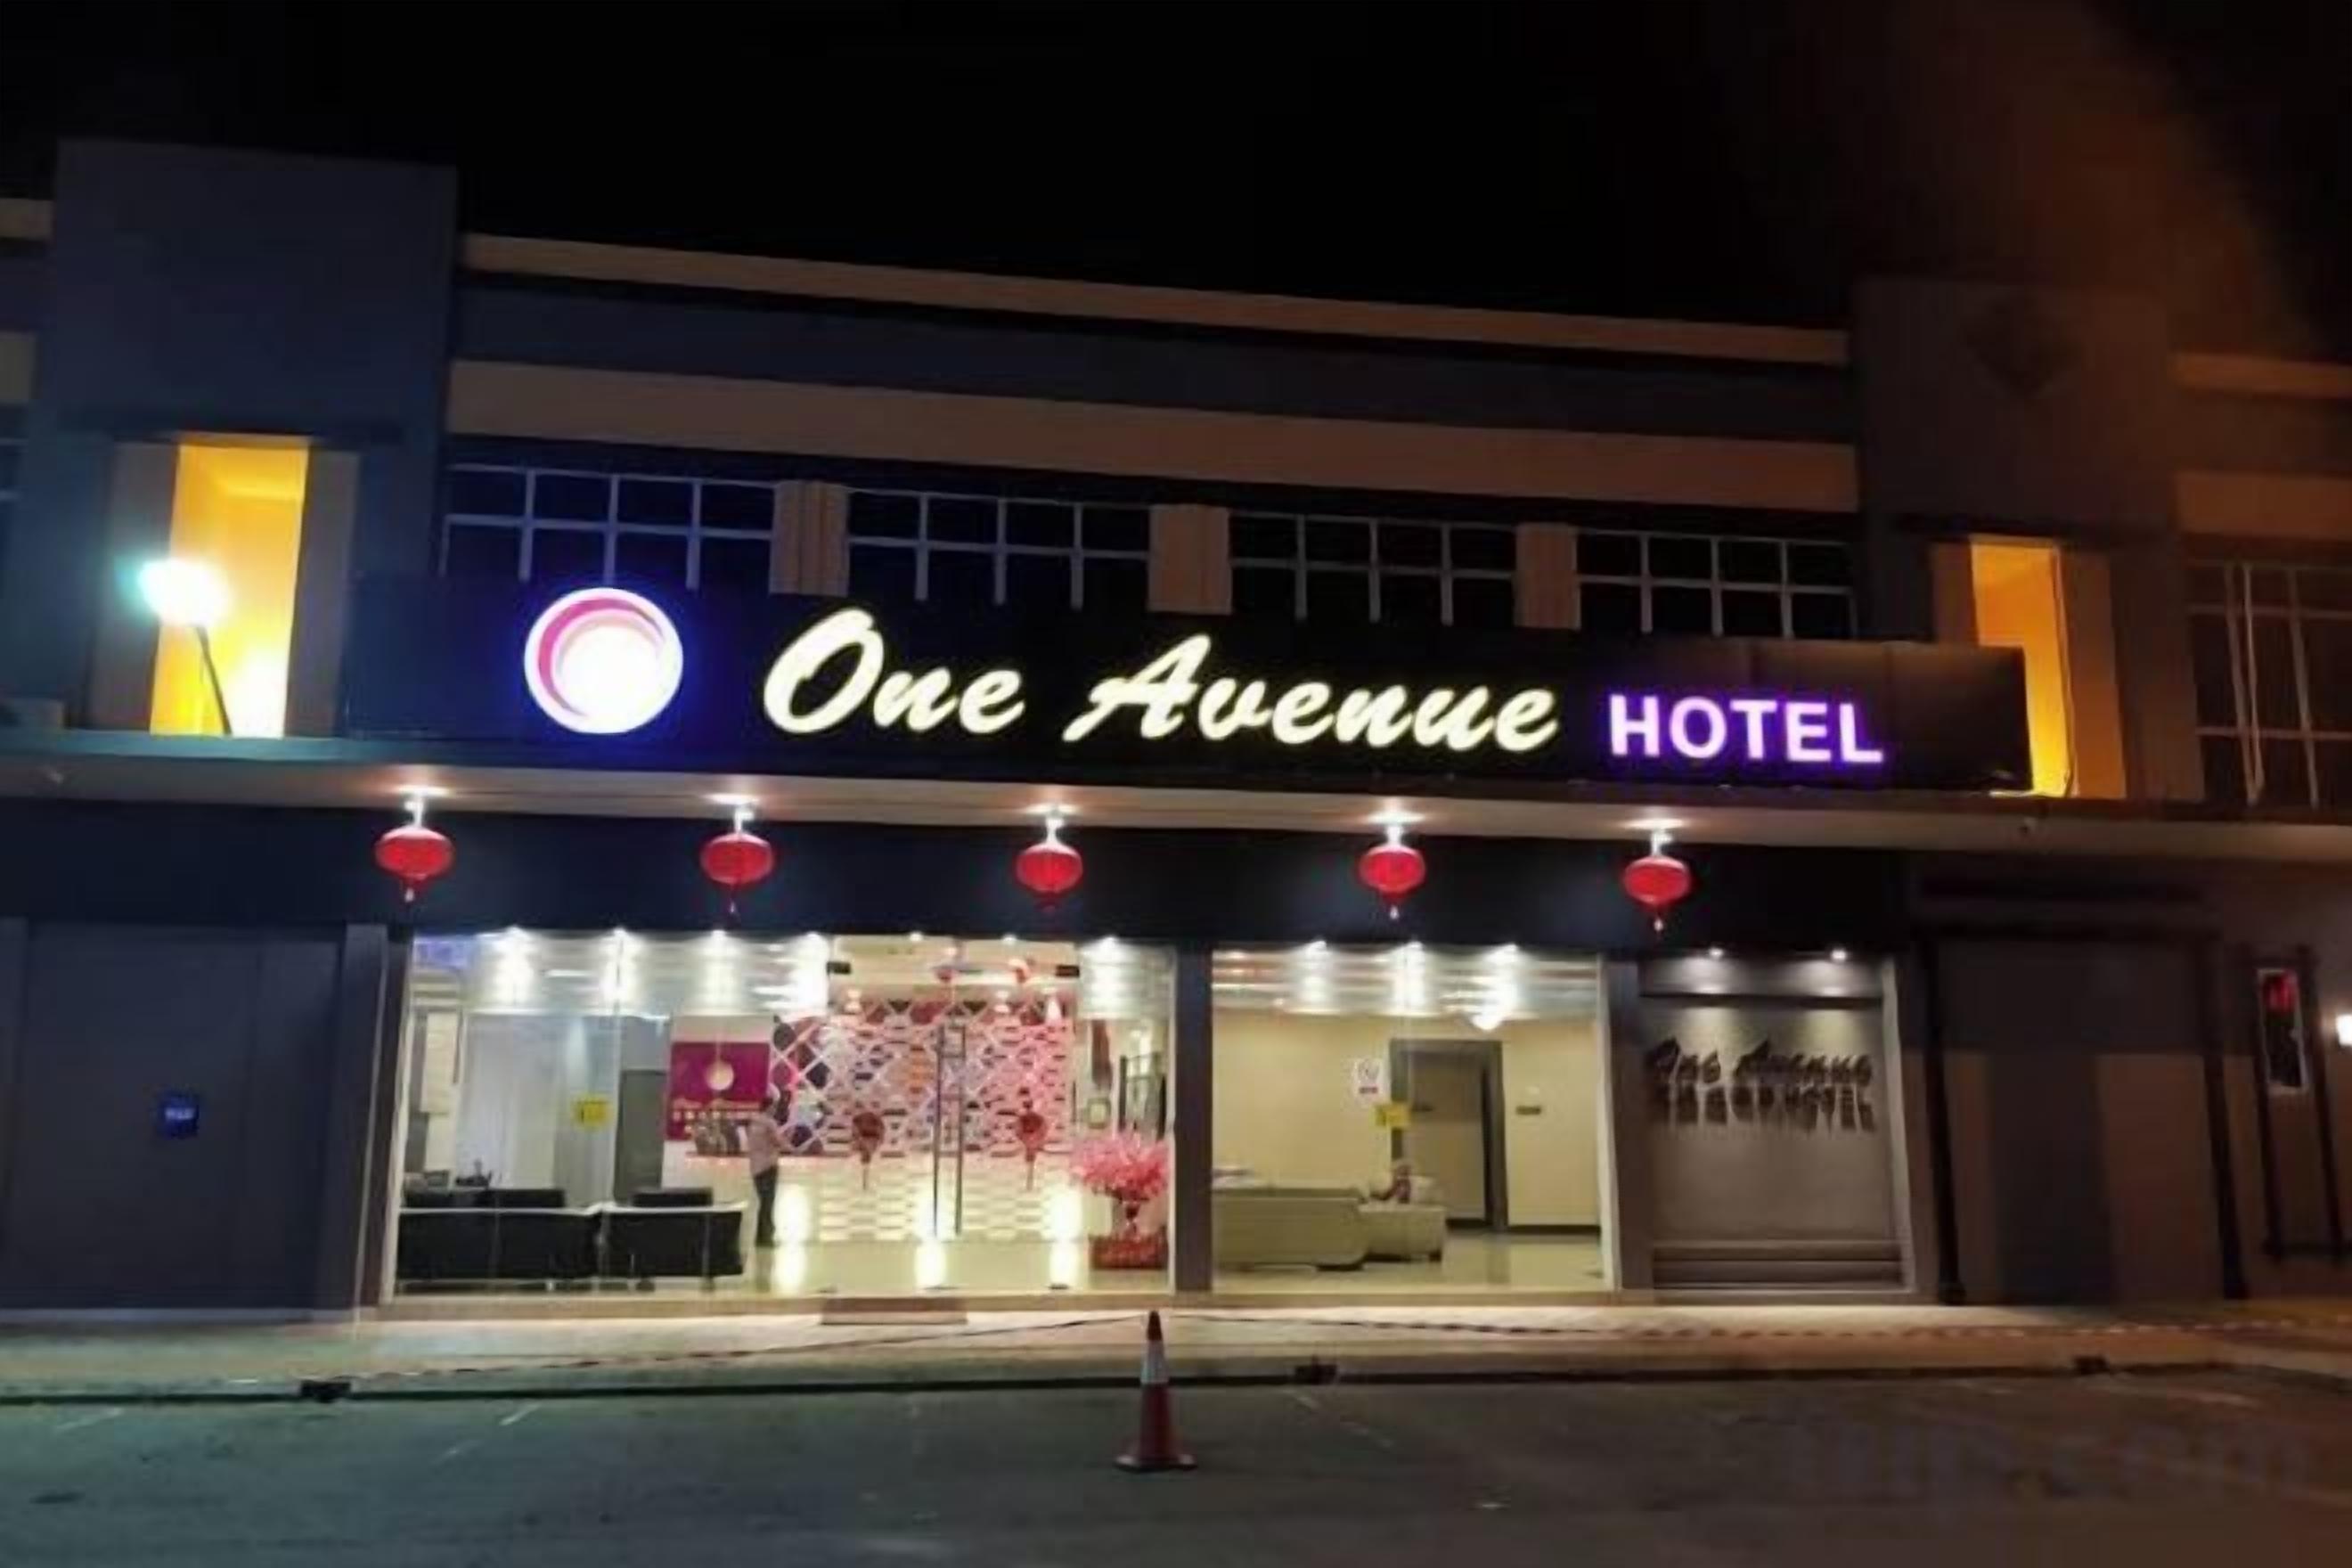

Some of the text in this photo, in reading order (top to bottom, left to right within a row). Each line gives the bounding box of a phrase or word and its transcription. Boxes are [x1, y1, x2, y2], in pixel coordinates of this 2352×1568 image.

[763, 608, 1884, 764] One Avenue HOTEL
